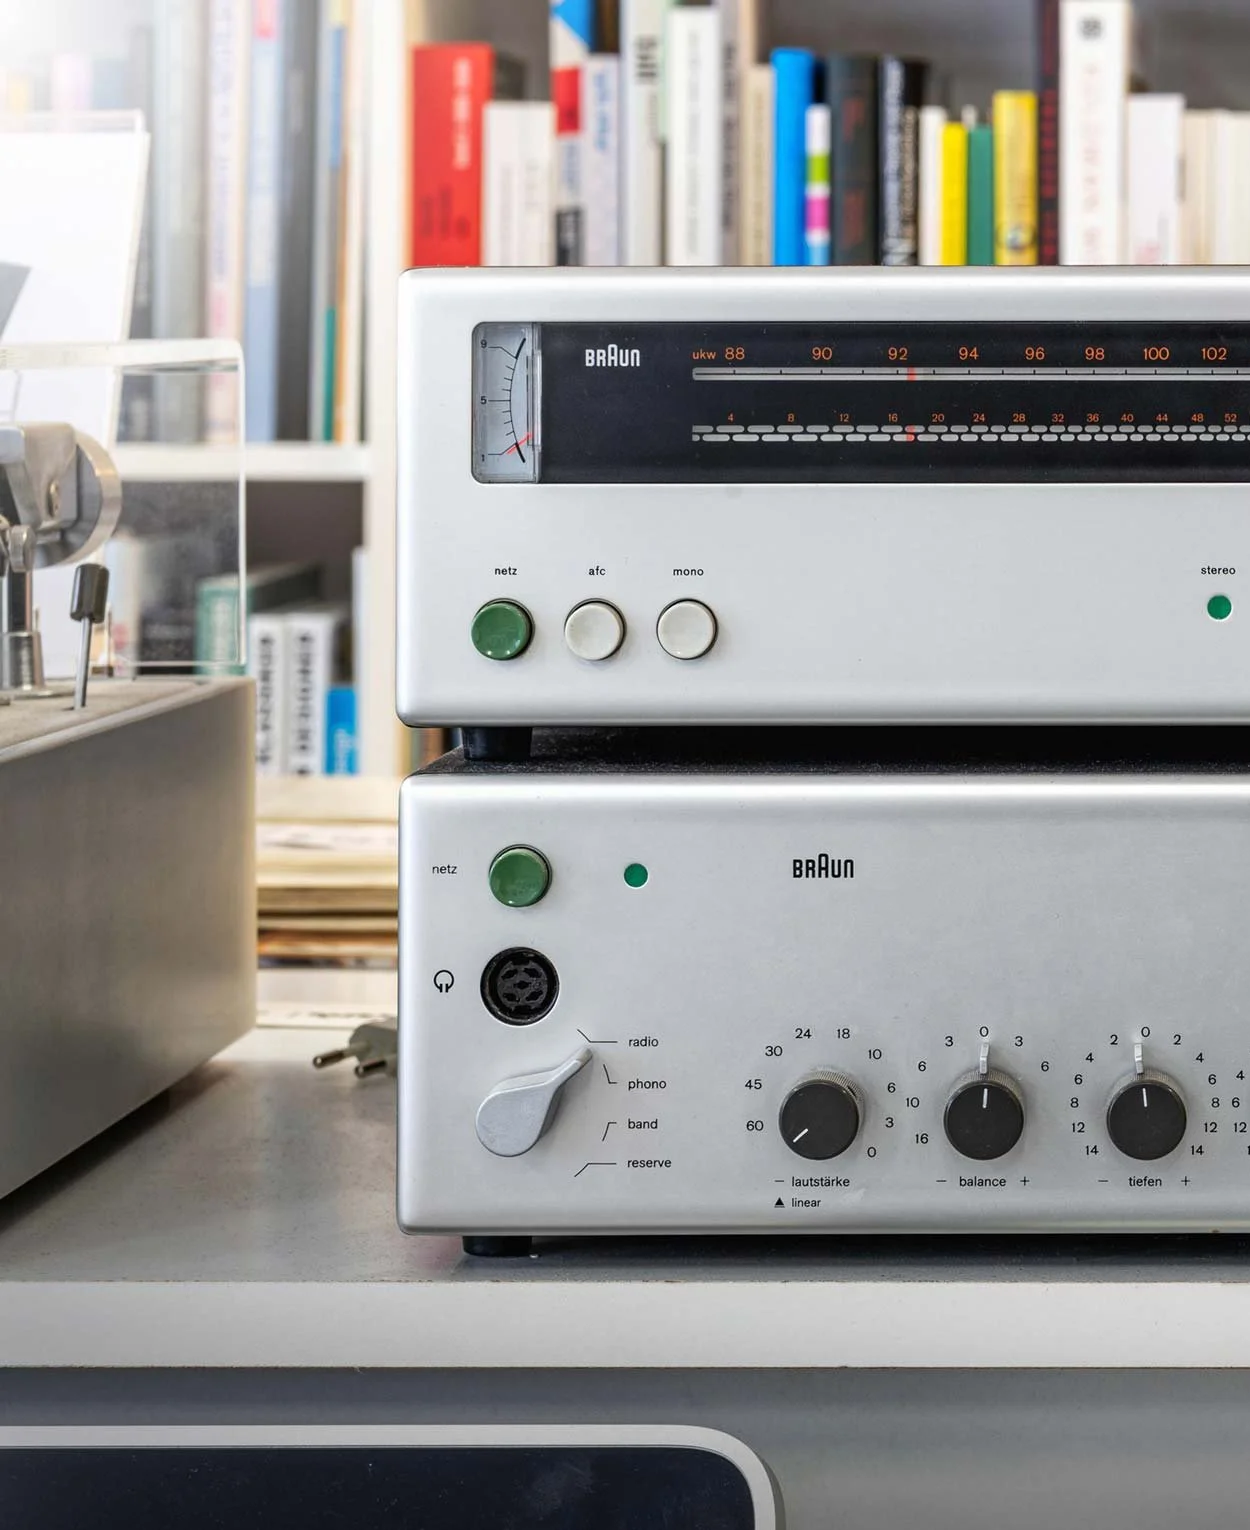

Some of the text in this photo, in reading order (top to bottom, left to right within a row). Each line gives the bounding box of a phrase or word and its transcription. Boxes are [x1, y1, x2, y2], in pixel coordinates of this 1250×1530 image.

[480, 337, 490, 350] 9
[586, 344, 640, 366] BRAUN
[692, 348, 717, 360] ukw
[724, 346, 746, 361] 88
[811, 346, 833, 361] 90
[887, 346, 908, 361] 92
[958, 346, 979, 361] 94
[1024, 346, 1046, 361] 96
[1084, 346, 1105, 361] 98
[1143, 346, 1170, 361] 100
[1201, 346, 1227, 361] 102
[480, 395, 487, 406] 5
[727, 412, 734, 422] 4
[787, 412, 795, 423] 8
[839, 412, 850, 423] 12
[888, 412, 899, 423] 16
[931, 413, 945, 423] 20
[973, 412, 986, 423] 24
[1012, 413, 1026, 423] 28
[1051, 412, 1065, 423] 32
[1086, 413, 1100, 423] 36
[1120, 413, 1135, 423] 40
[1155, 413, 1169, 422] 44
[1191, 412, 1204, 423] 48
[1224, 412, 1238, 423] 52
[494, 566, 518, 576] netz
[588, 565, 606, 576] afc
[672, 568, 705, 577] mono
[1200, 565, 1236, 575] stereo
[432, 864, 458, 875] netz
[793, 853, 853, 878] BRAUN
[795, 1027, 813, 1039] 24
[836, 1027, 851, 1040] 18
[979, 1025, 990, 1038] 0
[1140, 1026, 1151, 1038] 0
[628, 1035, 659, 1048] radio
[944, 1035, 954, 1048] 3
[1014, 1035, 1024, 1048] 3
[1109, 1033, 1119, 1046] 2
[1173, 1033, 1182, 1046] 2
[764, 1045, 783, 1057] 30
[868, 1048, 883, 1060] 10
[1085, 1052, 1095, 1063] 4
[1195, 1052, 1205, 1064] 4
[917, 1060, 927, 1072] 6
[1040, 1060, 1050, 1073] 6
[1074, 1073, 1083, 1086] 6
[1207, 1073, 1217, 1086] 6
[1235, 1069, 1246, 1081] 4
[627, 1078, 667, 1092] phono
[744, 1078, 763, 1090] 45
[887, 1081, 897, 1094] 6
[905, 1096, 920, 1109] 10
[1069, 1096, 1080, 1109] 8
[1211, 1096, 1221, 1109] 8
[1231, 1096, 1241, 1109] 6
[627, 1118, 658, 1130] band
[745, 1119, 765, 1132] 60
[885, 1116, 895, 1129] 3
[1071, 1121, 1086, 1134] 12
[1203, 1121, 1218, 1133] 12
[1233, 1121, 1248, 1133] 12
[915, 1132, 929, 1145] 16
[866, 1146, 877, 1159] 0
[1085, 1144, 1100, 1156] 14
[1190, 1144, 1205, 1156] 14
[627, 1159, 672, 1169] reserve
[791, 1175, 851, 1188] lautstärke
[959, 1175, 1007, 1188] balance
[1128, 1175, 1163, 1187] tiefen
[791, 1197, 822, 1208] linear
